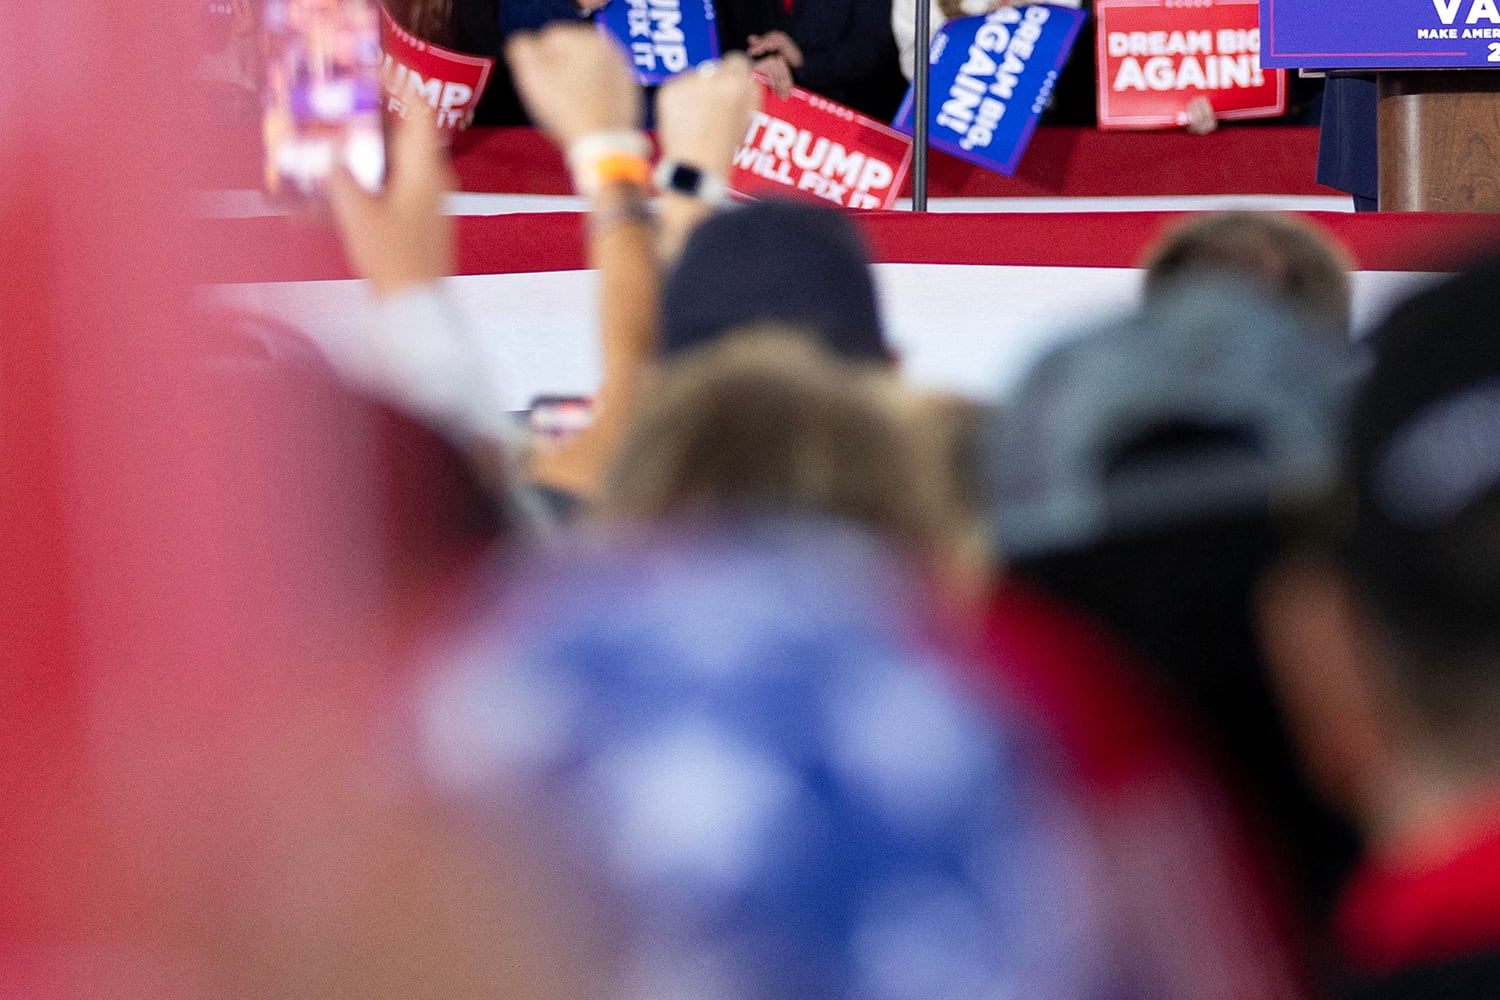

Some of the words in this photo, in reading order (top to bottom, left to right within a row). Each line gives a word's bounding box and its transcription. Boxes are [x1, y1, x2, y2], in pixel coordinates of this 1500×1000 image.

[990, 4, 1050, 99] DREAM
[1108, 28, 1212, 57] DREAM
[1417, 28, 1458, 39] MAKE
[631, 39, 657, 71] IT
[1113, 54, 1264, 91] AGAIN!
[959, 97, 1007, 152] BIG,
[748, 111, 893, 190] TRUMP
